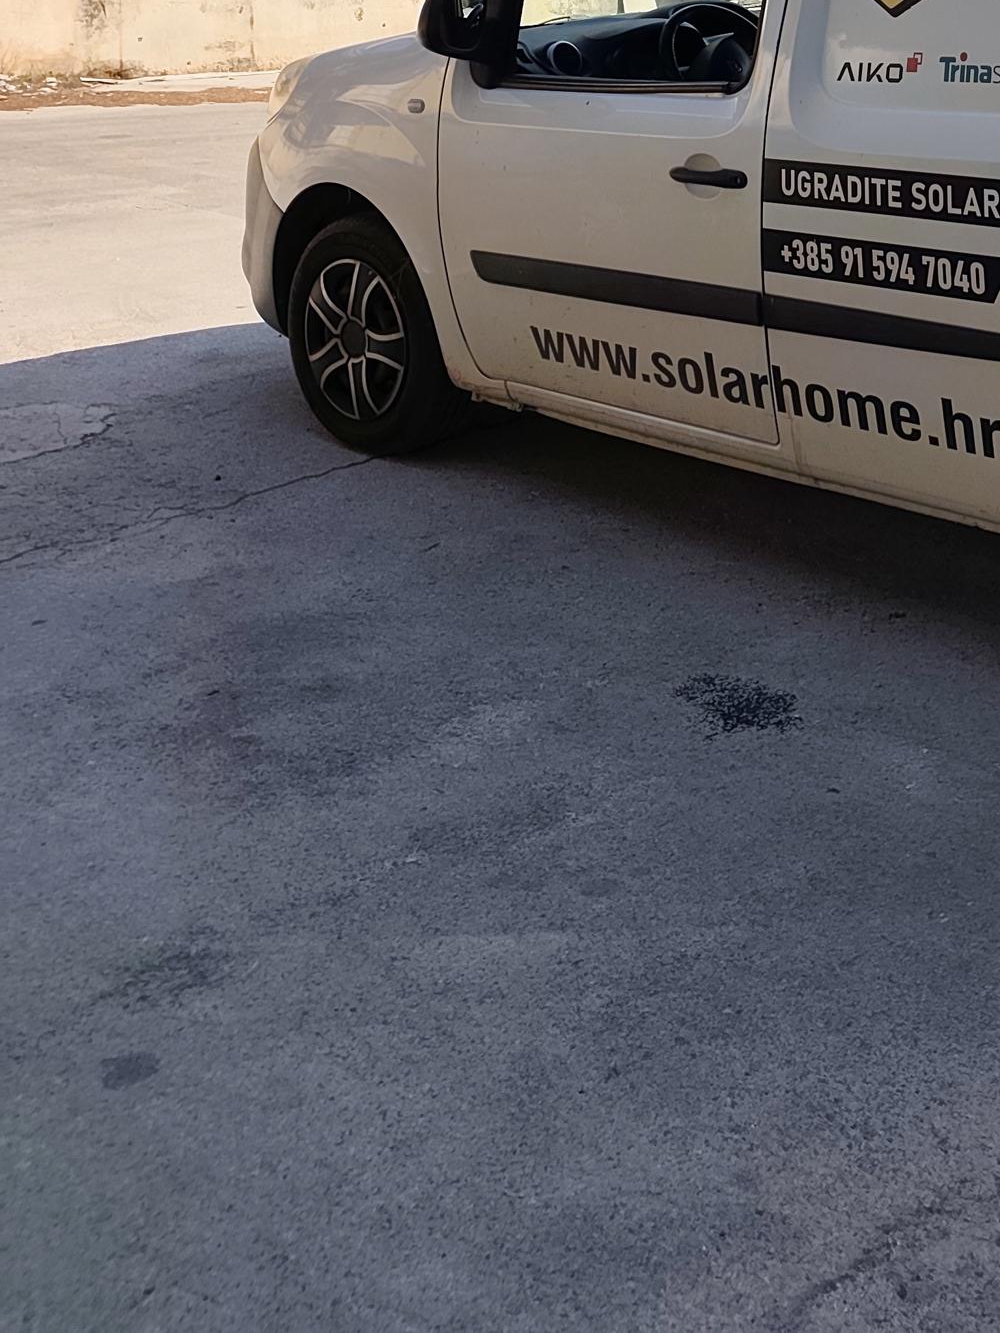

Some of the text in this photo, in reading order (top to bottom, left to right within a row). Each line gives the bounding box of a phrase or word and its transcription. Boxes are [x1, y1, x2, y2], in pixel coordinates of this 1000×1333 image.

[837, 61, 904, 84] AIKO
[780, 167, 903, 209] UGRADITE
[780, 238, 986, 296] +385 91 594 7040
